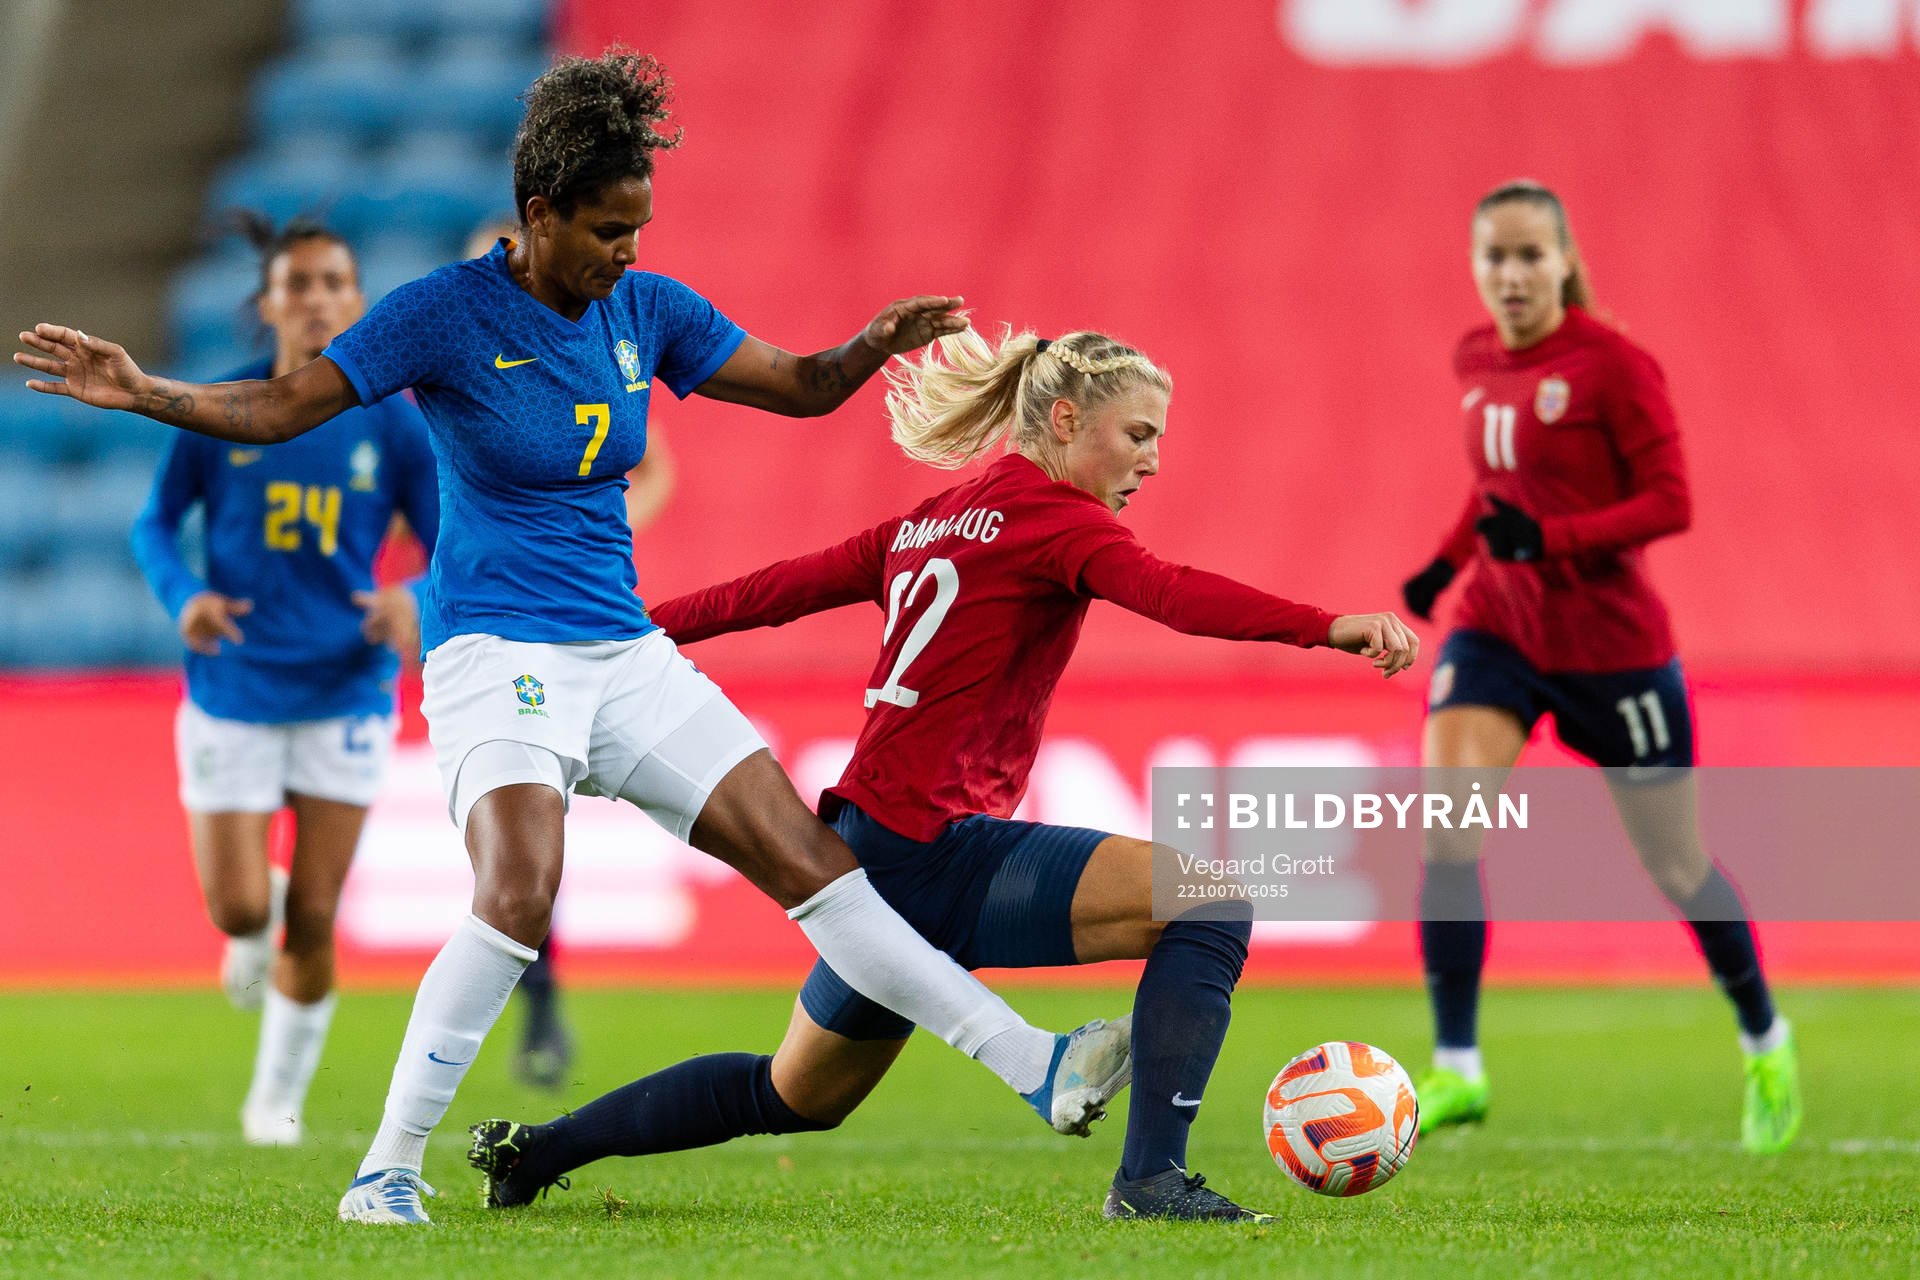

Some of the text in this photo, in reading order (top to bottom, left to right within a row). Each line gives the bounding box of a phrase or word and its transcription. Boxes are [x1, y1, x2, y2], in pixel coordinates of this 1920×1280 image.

[575, 403, 610, 476] 7
[1483, 404, 1516, 469] 11
[265, 481, 342, 557] 24
[1616, 690, 1670, 757] 11
